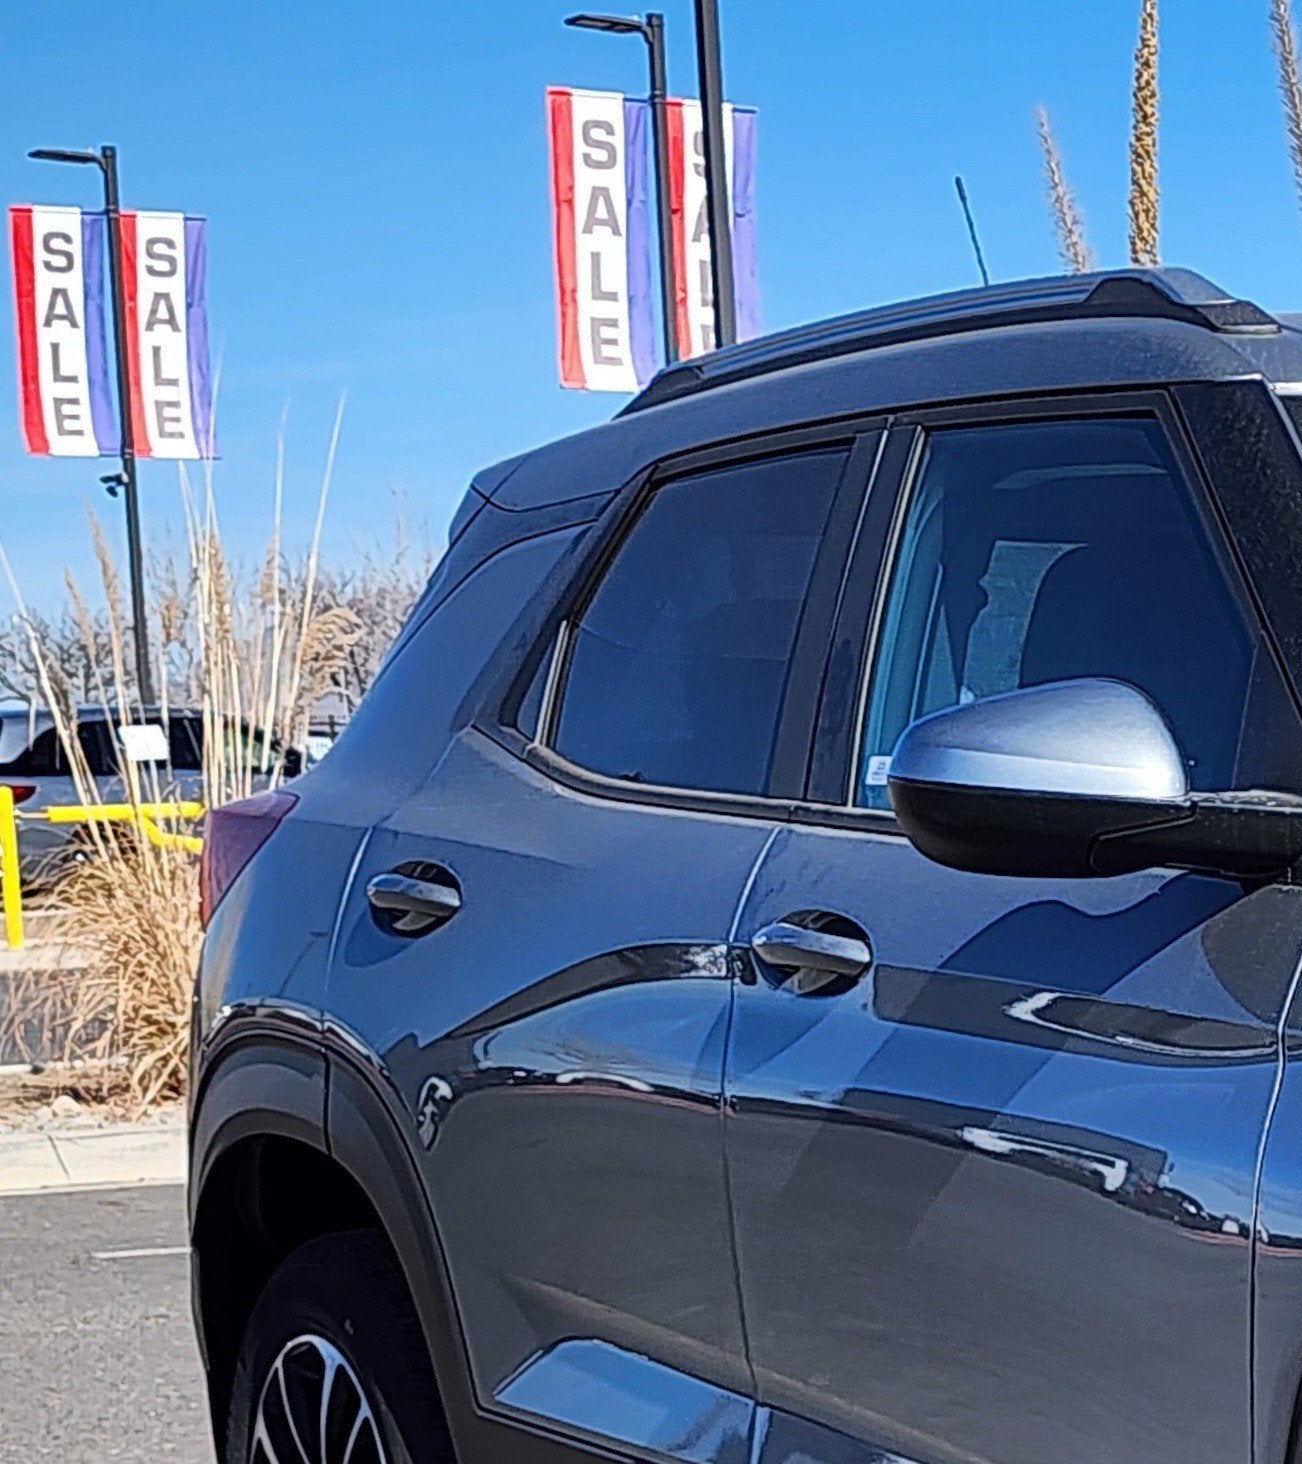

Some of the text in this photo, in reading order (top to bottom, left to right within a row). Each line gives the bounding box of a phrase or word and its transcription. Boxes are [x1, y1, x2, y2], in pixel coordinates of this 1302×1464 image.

[43, 231, 85, 436] SALE
[145, 237, 186, 439] SALE
[580, 119, 624, 367] SALE
